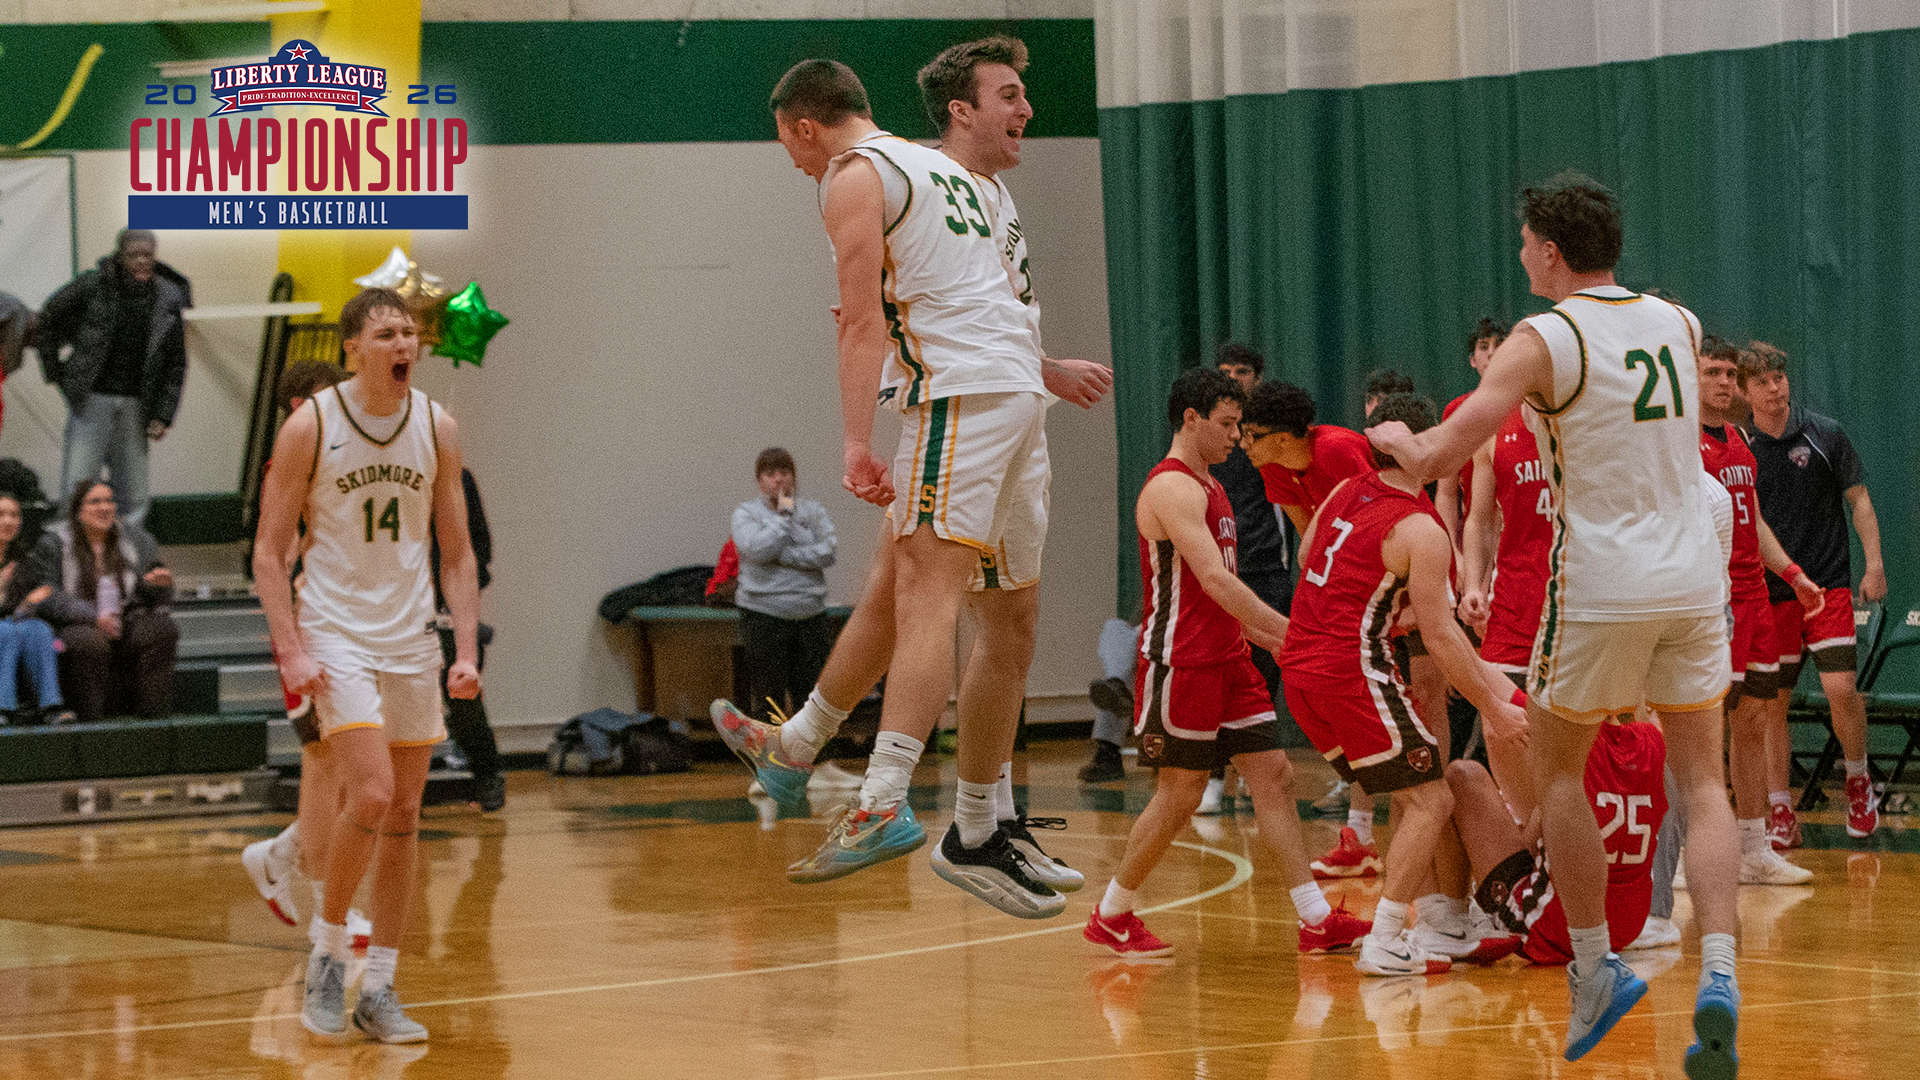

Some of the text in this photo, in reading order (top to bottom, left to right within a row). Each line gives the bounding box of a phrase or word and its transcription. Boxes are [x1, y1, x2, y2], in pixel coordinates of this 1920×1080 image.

[929, 171, 991, 238] 33
[1624, 345, 1685, 423] 21
[335, 464, 424, 494] SKIDMORE
[1719, 465, 1754, 488] SAINTS
[920, 484, 936, 513] S
[1535, 487, 1554, 522] 4
[1735, 491, 1750, 525] 5
[363, 497, 400, 542] 14
[1305, 517, 1354, 587] 3
[1596, 791, 1653, 865] 25
